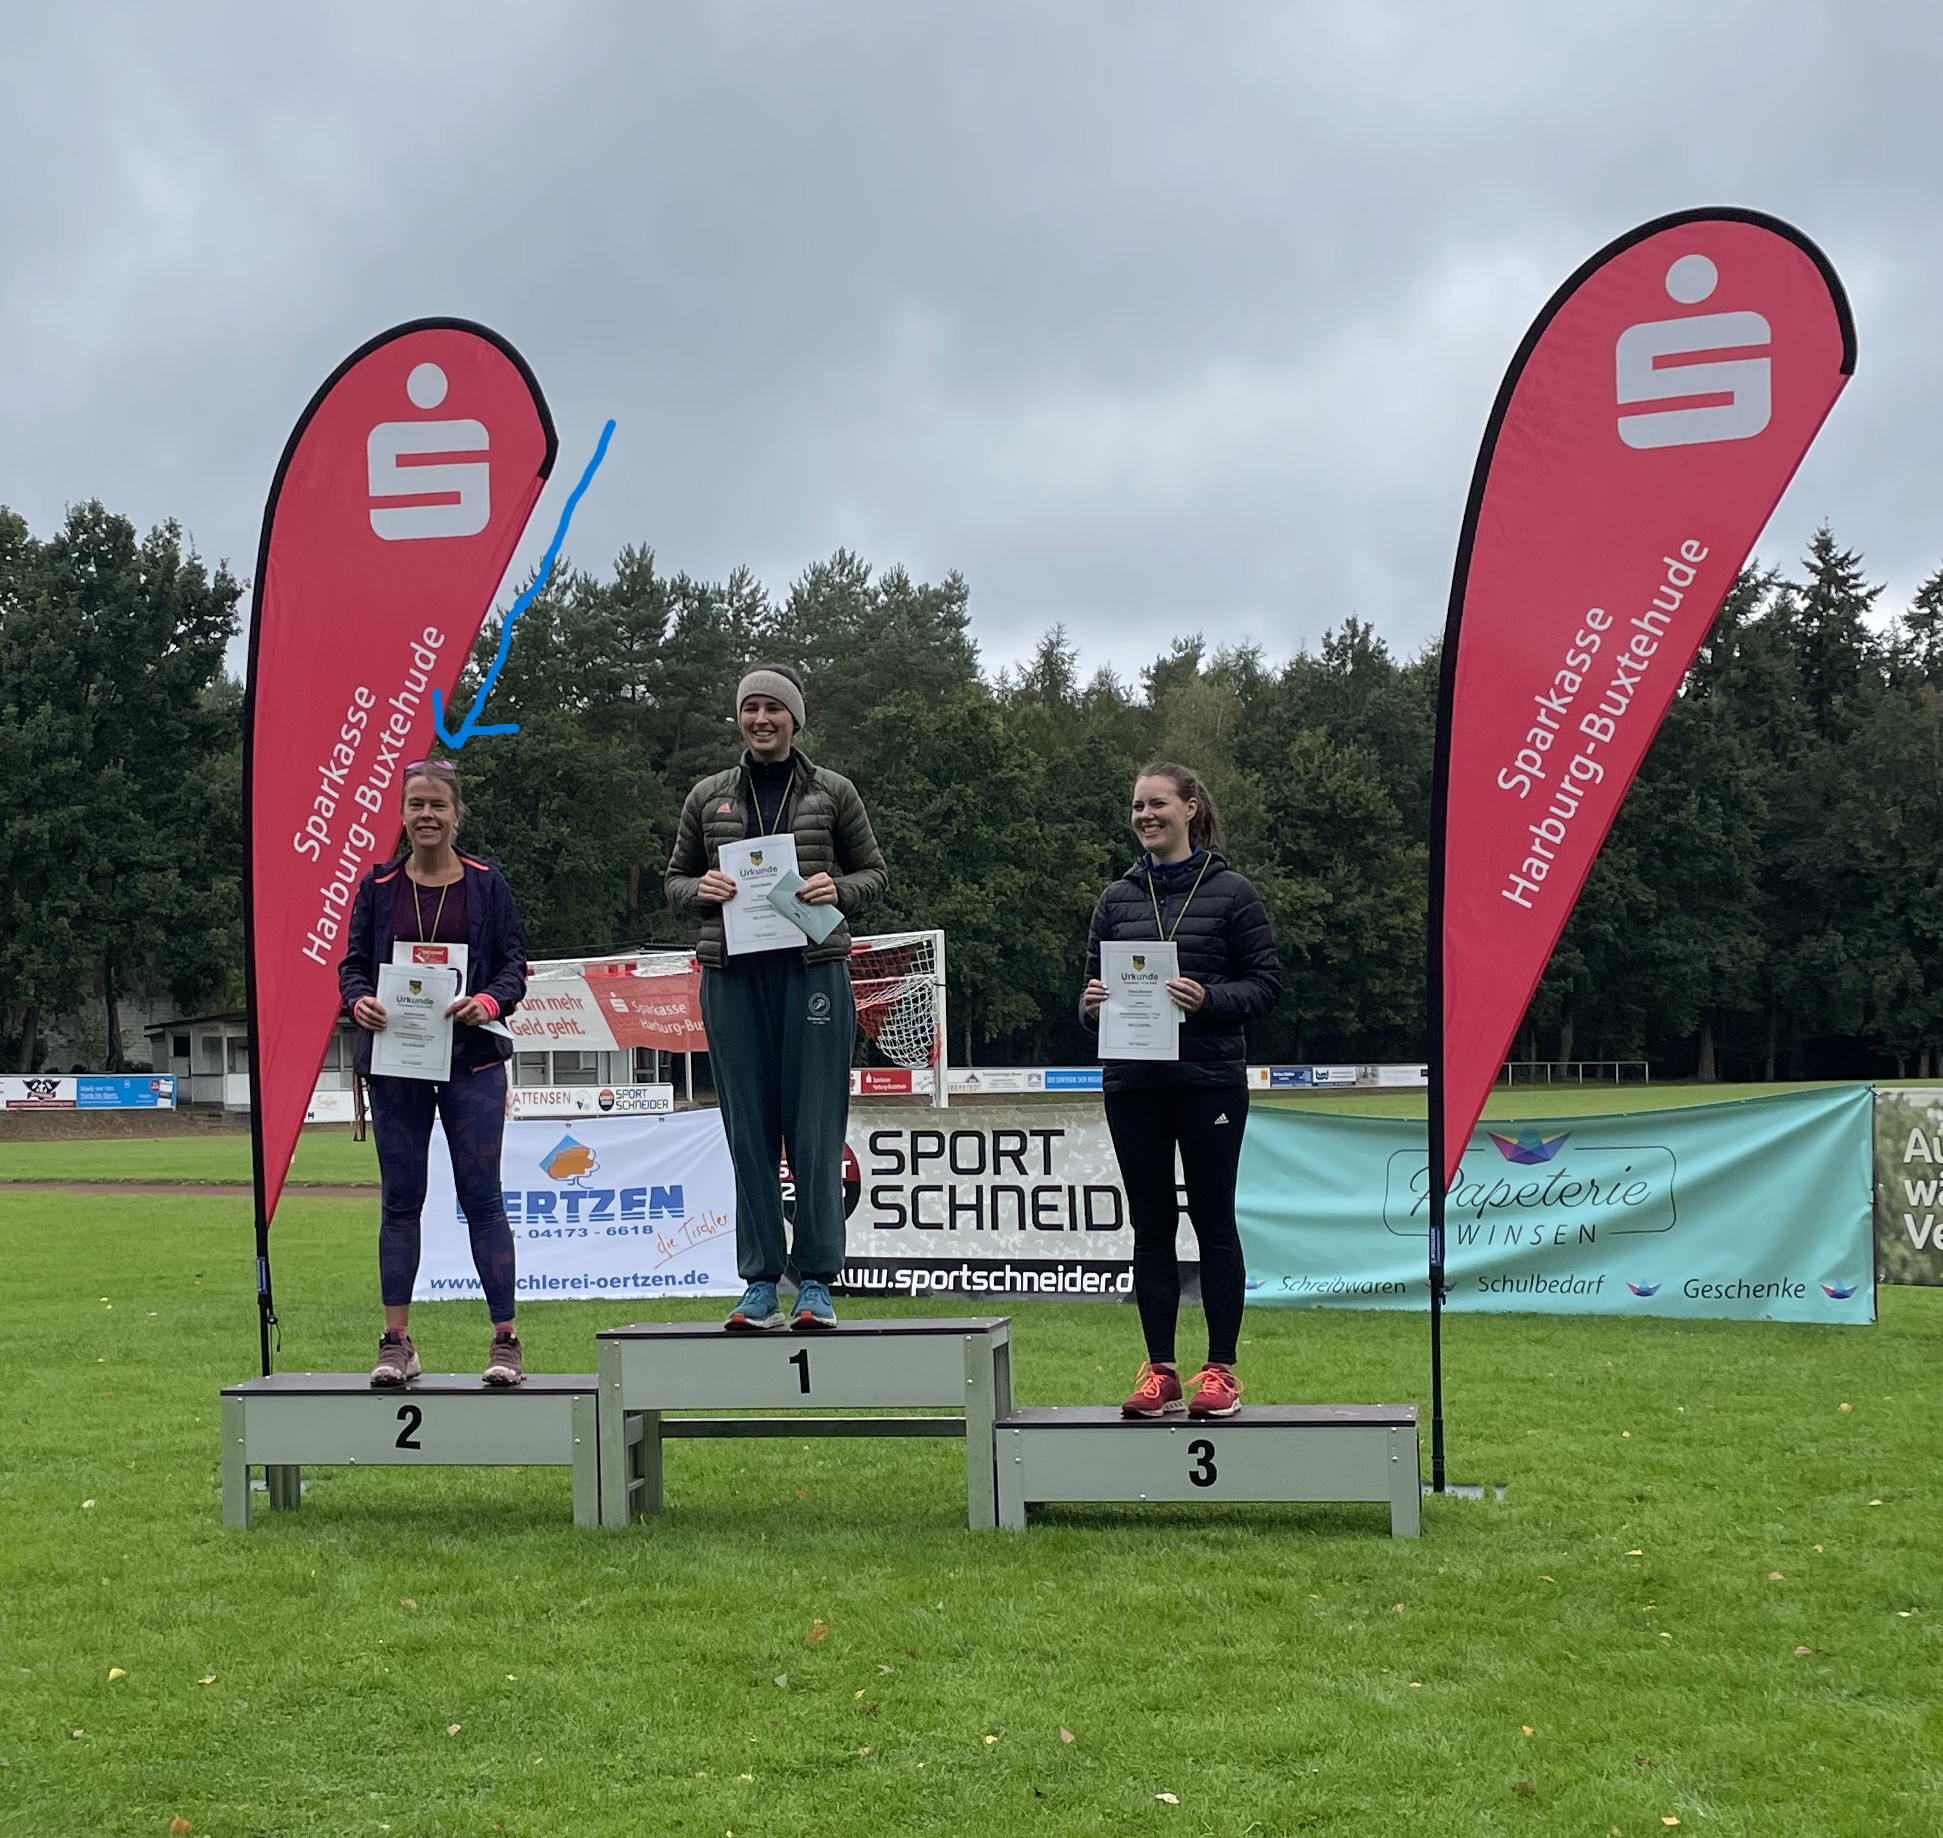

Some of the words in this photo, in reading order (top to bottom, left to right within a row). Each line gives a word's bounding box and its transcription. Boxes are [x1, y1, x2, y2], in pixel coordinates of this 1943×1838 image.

[1497, 606, 1613, 799] Sparkasse
[1501, 538, 1709, 909] Harburg-Buxtehude
[293, 686, 376, 863] Sparkasse
[302, 625, 445, 966] Harburg-Buxtehude
[739, 865, 778, 878] Urkunde
[1120, 972, 1159, 981] Urkunde
[396, 994, 434, 1006] Urkunde
[549, 993, 585, 1011] mehr
[632, 1001, 687, 1016] Sparkasse
[509, 1017, 545, 1037] Geld
[546, 1016, 586, 1040] geht.
[513, 1091, 571, 1105] ATTENSEN
[616, 1089, 648, 1100] SPORT
[616, 1099, 669, 1110] SCHNEIDER
[869, 1129, 1065, 1176] SPORT
[456, 1184, 685, 1225] ERTZEN
[1409, 1166, 1652, 1219] Papeterie
[871, 1183, 1188, 1232] SCHNEID
[528, 1226, 588, 1239] 04173
[606, 1224, 654, 1238] 6618
[678, 1209, 728, 1245] Tischler
[1458, 1224, 1597, 1246] WINSEN
[430, 1269, 710, 1291] wwwchlerei-oertzen.de
[830, 1264, 1134, 1297] ww.sportschneider.d
[1277, 1275, 1406, 1295] Schreibwaren
[1478, 1274, 1606, 1295] Schulbedarf
[1683, 1276, 1806, 1300] Geschenke
[789, 1348, 811, 1395] 1
[395, 1404, 423, 1451] 2
[1187, 1438, 1218, 1488] 3
